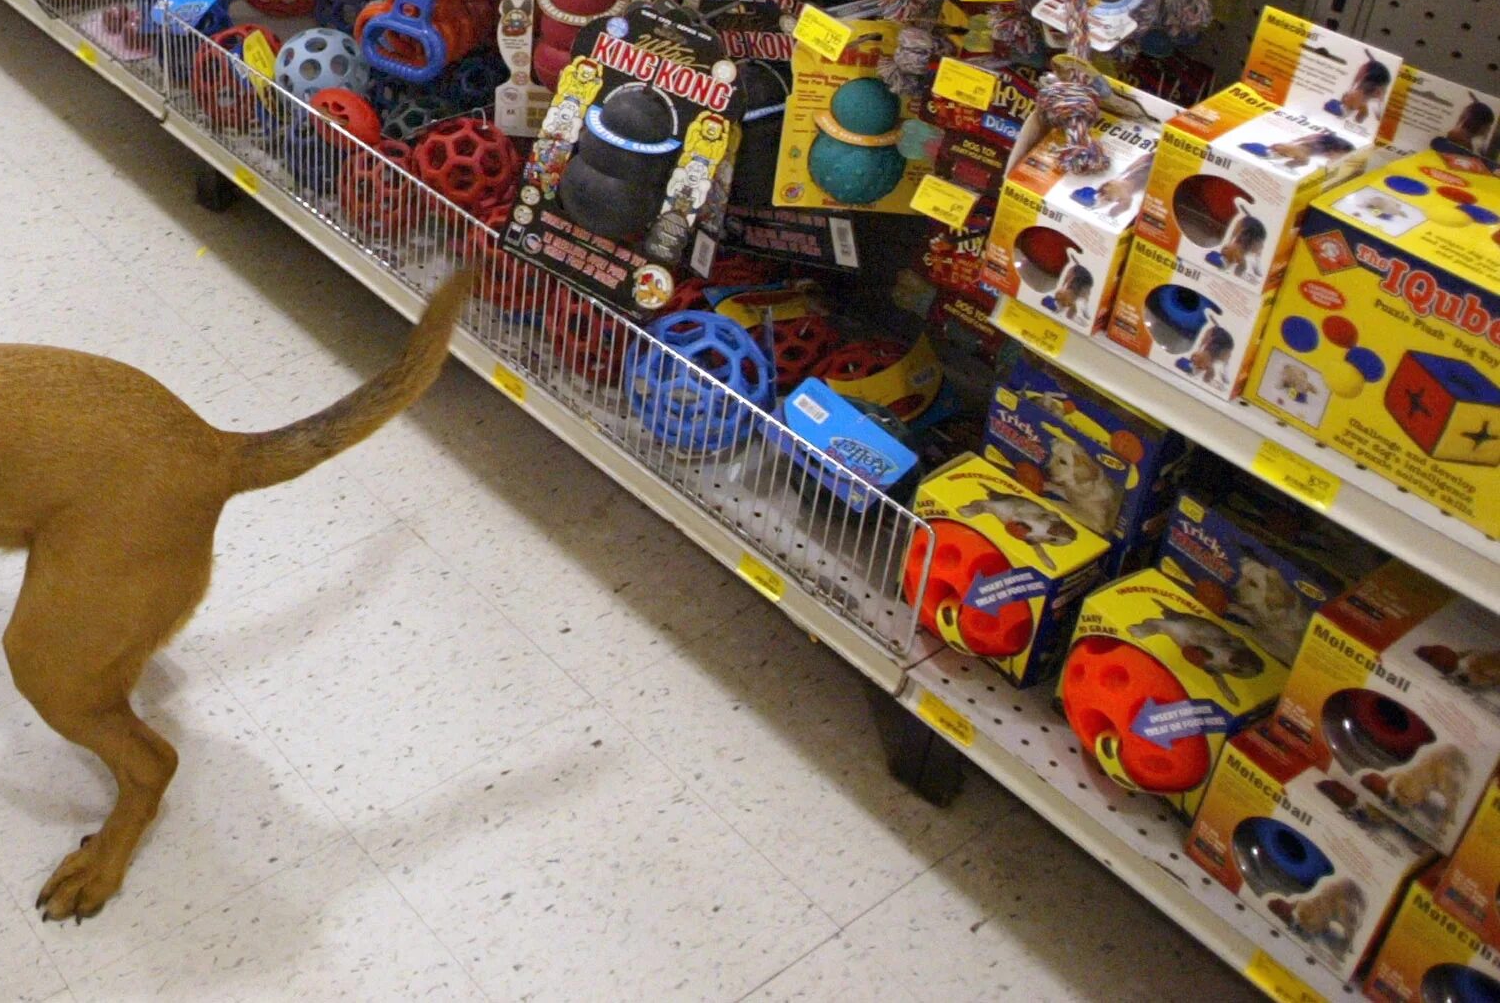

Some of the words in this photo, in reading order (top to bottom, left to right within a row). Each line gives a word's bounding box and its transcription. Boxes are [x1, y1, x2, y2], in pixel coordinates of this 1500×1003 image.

[744, 31, 795, 61] KON
[590, 31, 660, 82] KING
[654, 57, 734, 113] KONG
[1162, 130, 1233, 170] Molecuball
[1003, 185, 1063, 223] Molecuball
[1134, 240, 1202, 282] Molecuball
[1356, 244, 1390, 272] The
[1413, 319, 1446, 342] Plush
[996, 408, 1040, 443] Tricky
[1177, 519, 1229, 561] Tricky
[1313, 623, 1413, 694] Molecuball
[1226, 754, 1314, 828] Molecuball
